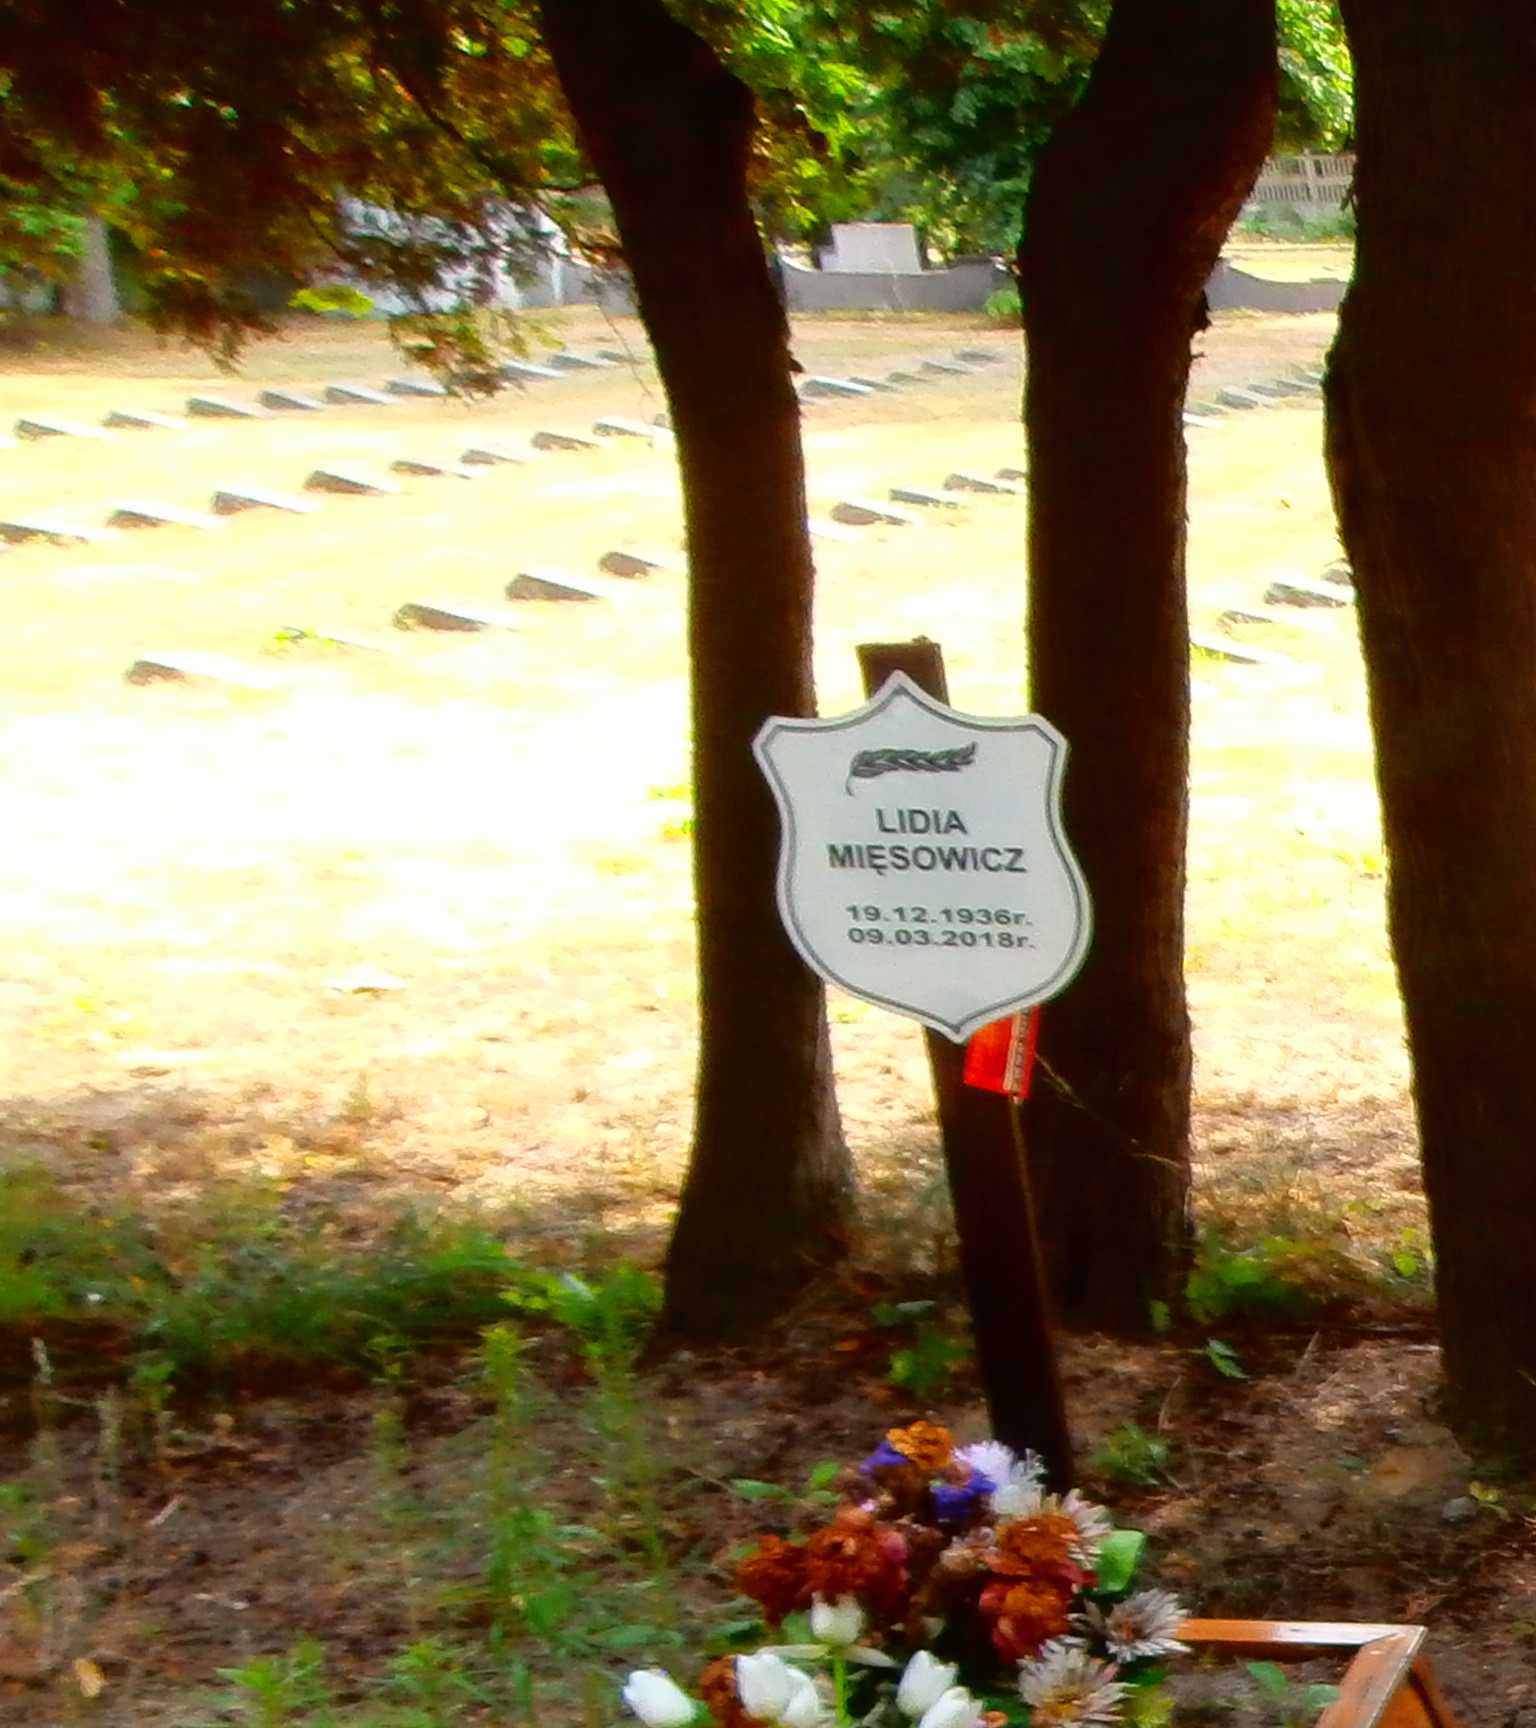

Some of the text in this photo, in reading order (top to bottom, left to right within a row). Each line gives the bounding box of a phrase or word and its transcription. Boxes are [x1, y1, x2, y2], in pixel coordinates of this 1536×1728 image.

[876, 808, 968, 835] LIDIA
[827, 844, 1027, 876] MIĘSOWICZ
[846, 904, 1034, 926] 19.12.1936r.
[847, 927, 1036, 948] 09.03.2018r.
